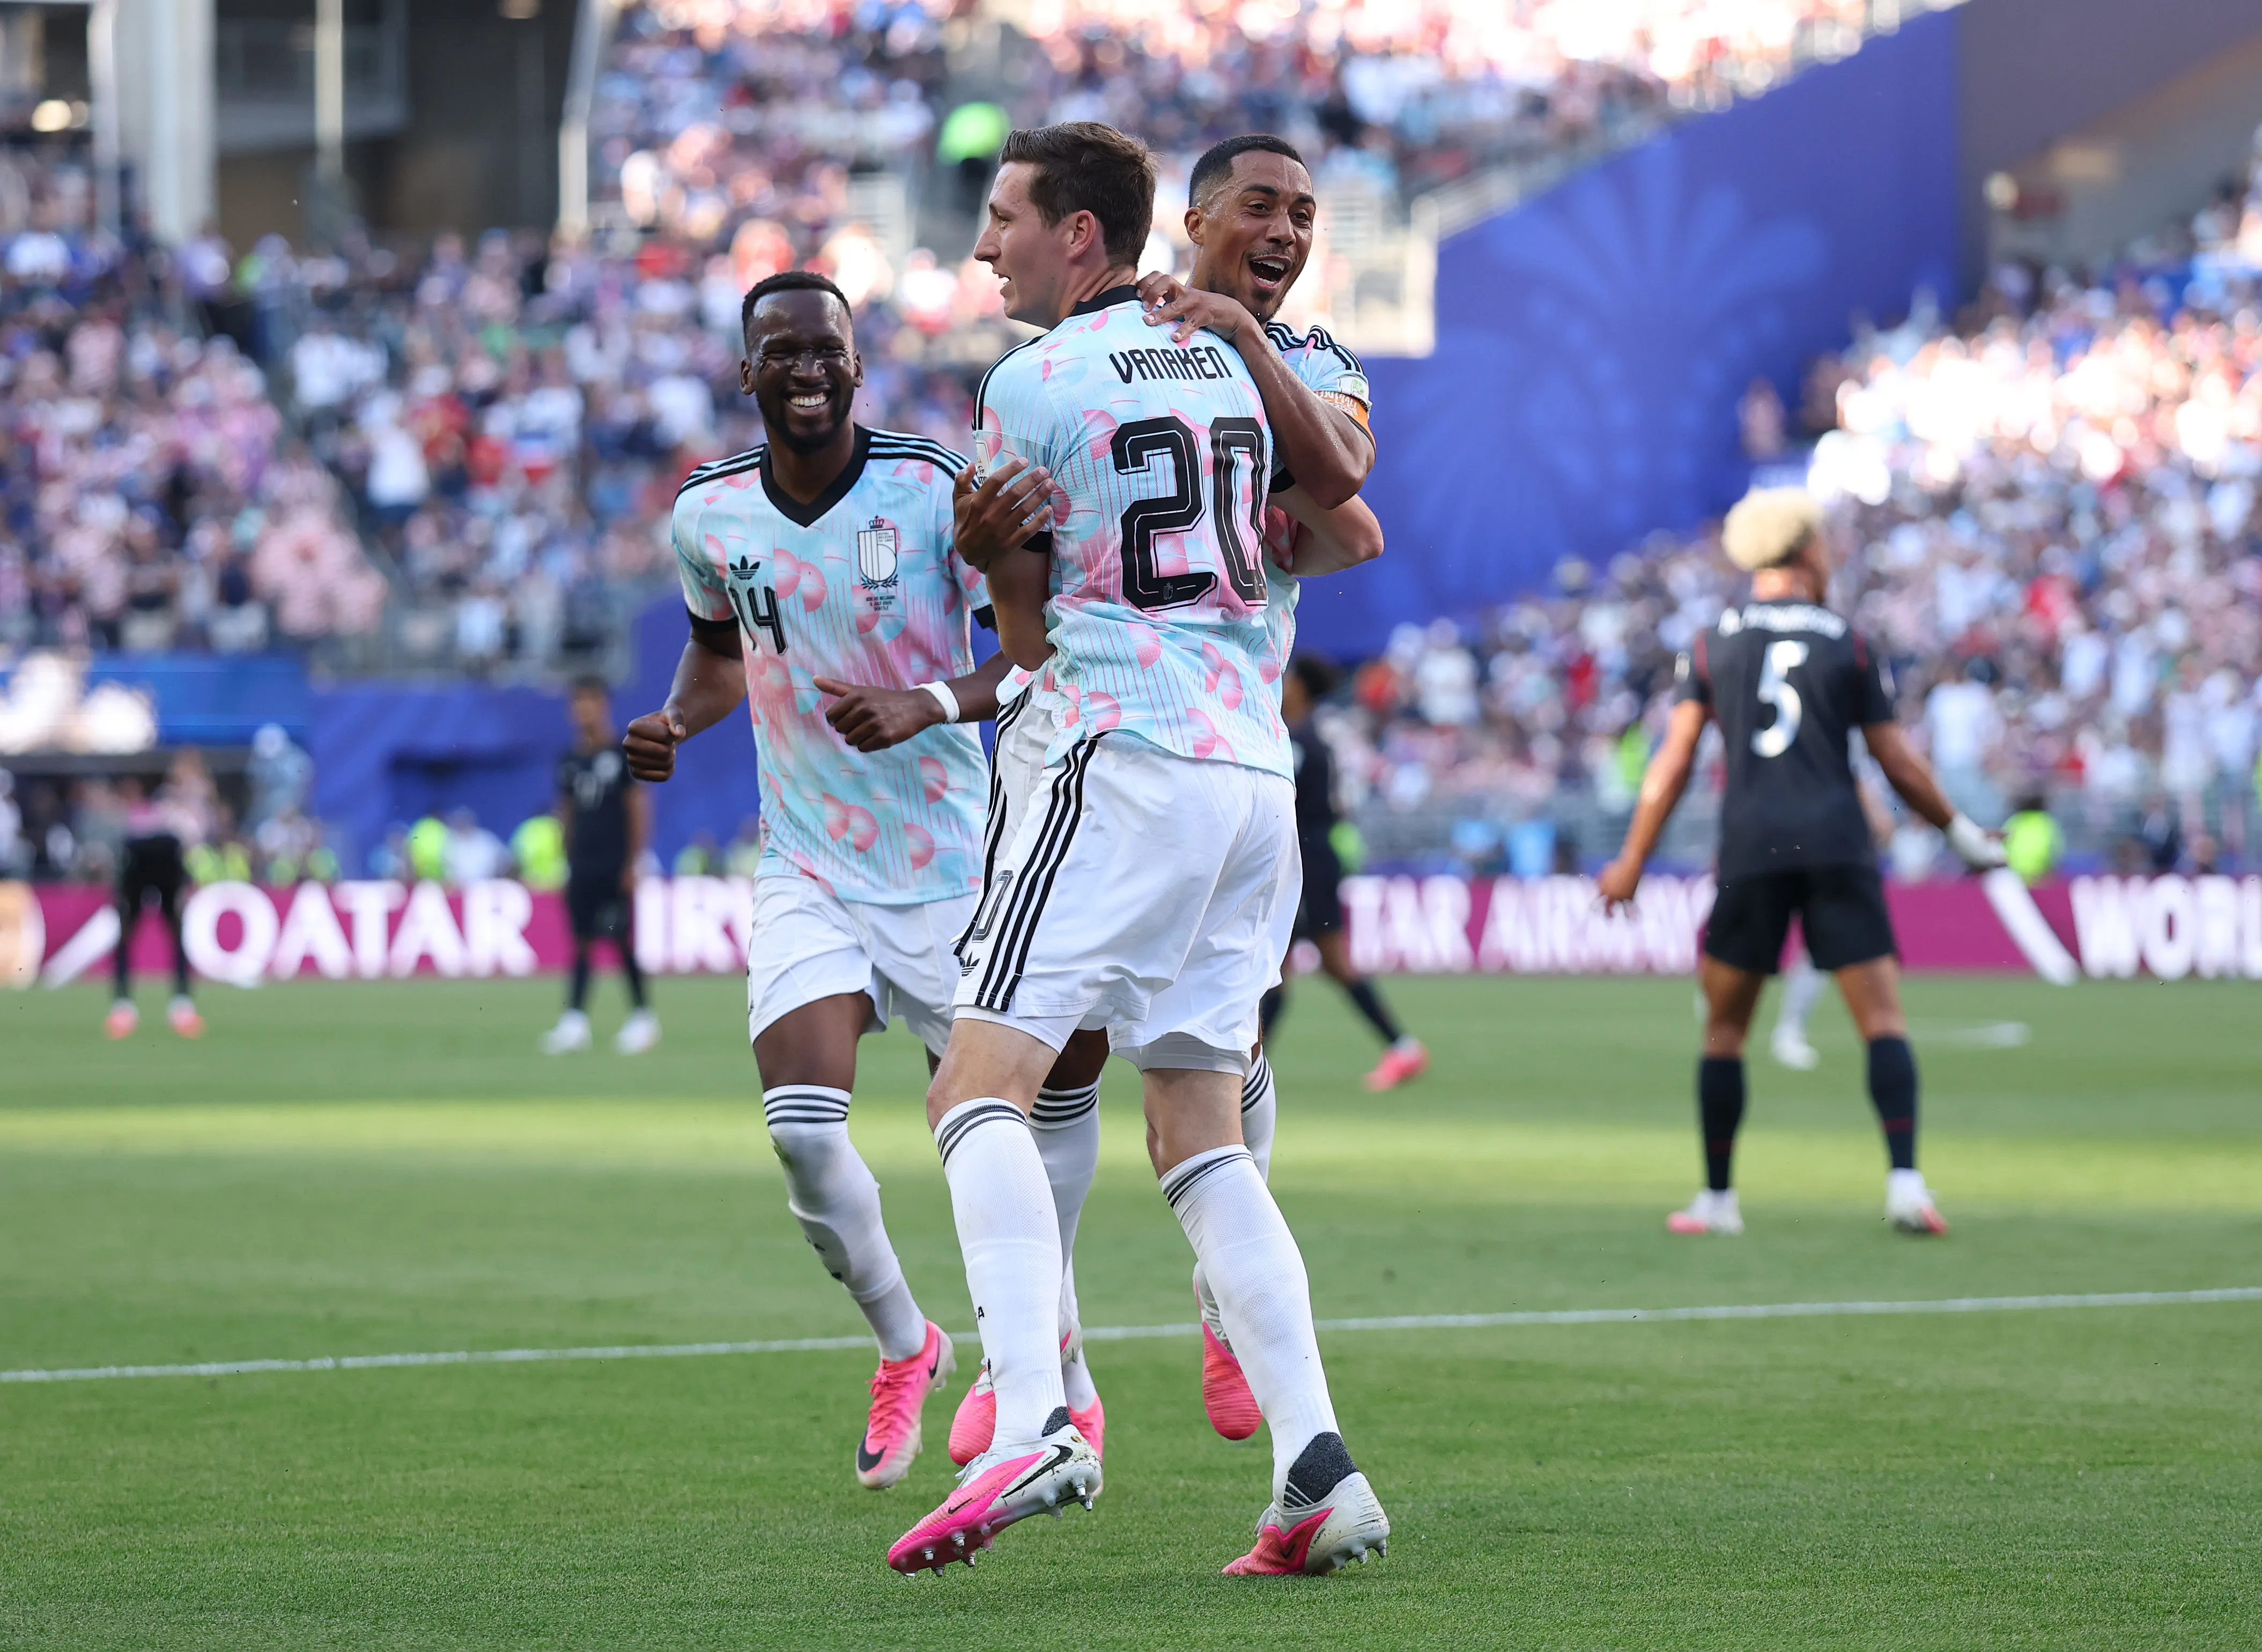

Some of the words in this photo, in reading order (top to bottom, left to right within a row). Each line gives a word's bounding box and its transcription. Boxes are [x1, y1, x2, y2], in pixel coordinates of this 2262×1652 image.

[1109, 346, 1232, 384] VANAKEN
[1111, 416, 1268, 612] 20
[728, 586, 788, 655] 14
[1749, 640, 1809, 758] 5
[182, 879, 537, 986] QATAR
[1336, 875, 1476, 973] TAR
[1477, 874, 1718, 973] AIRWAY
[2070, 873, 2262, 980] WORL
